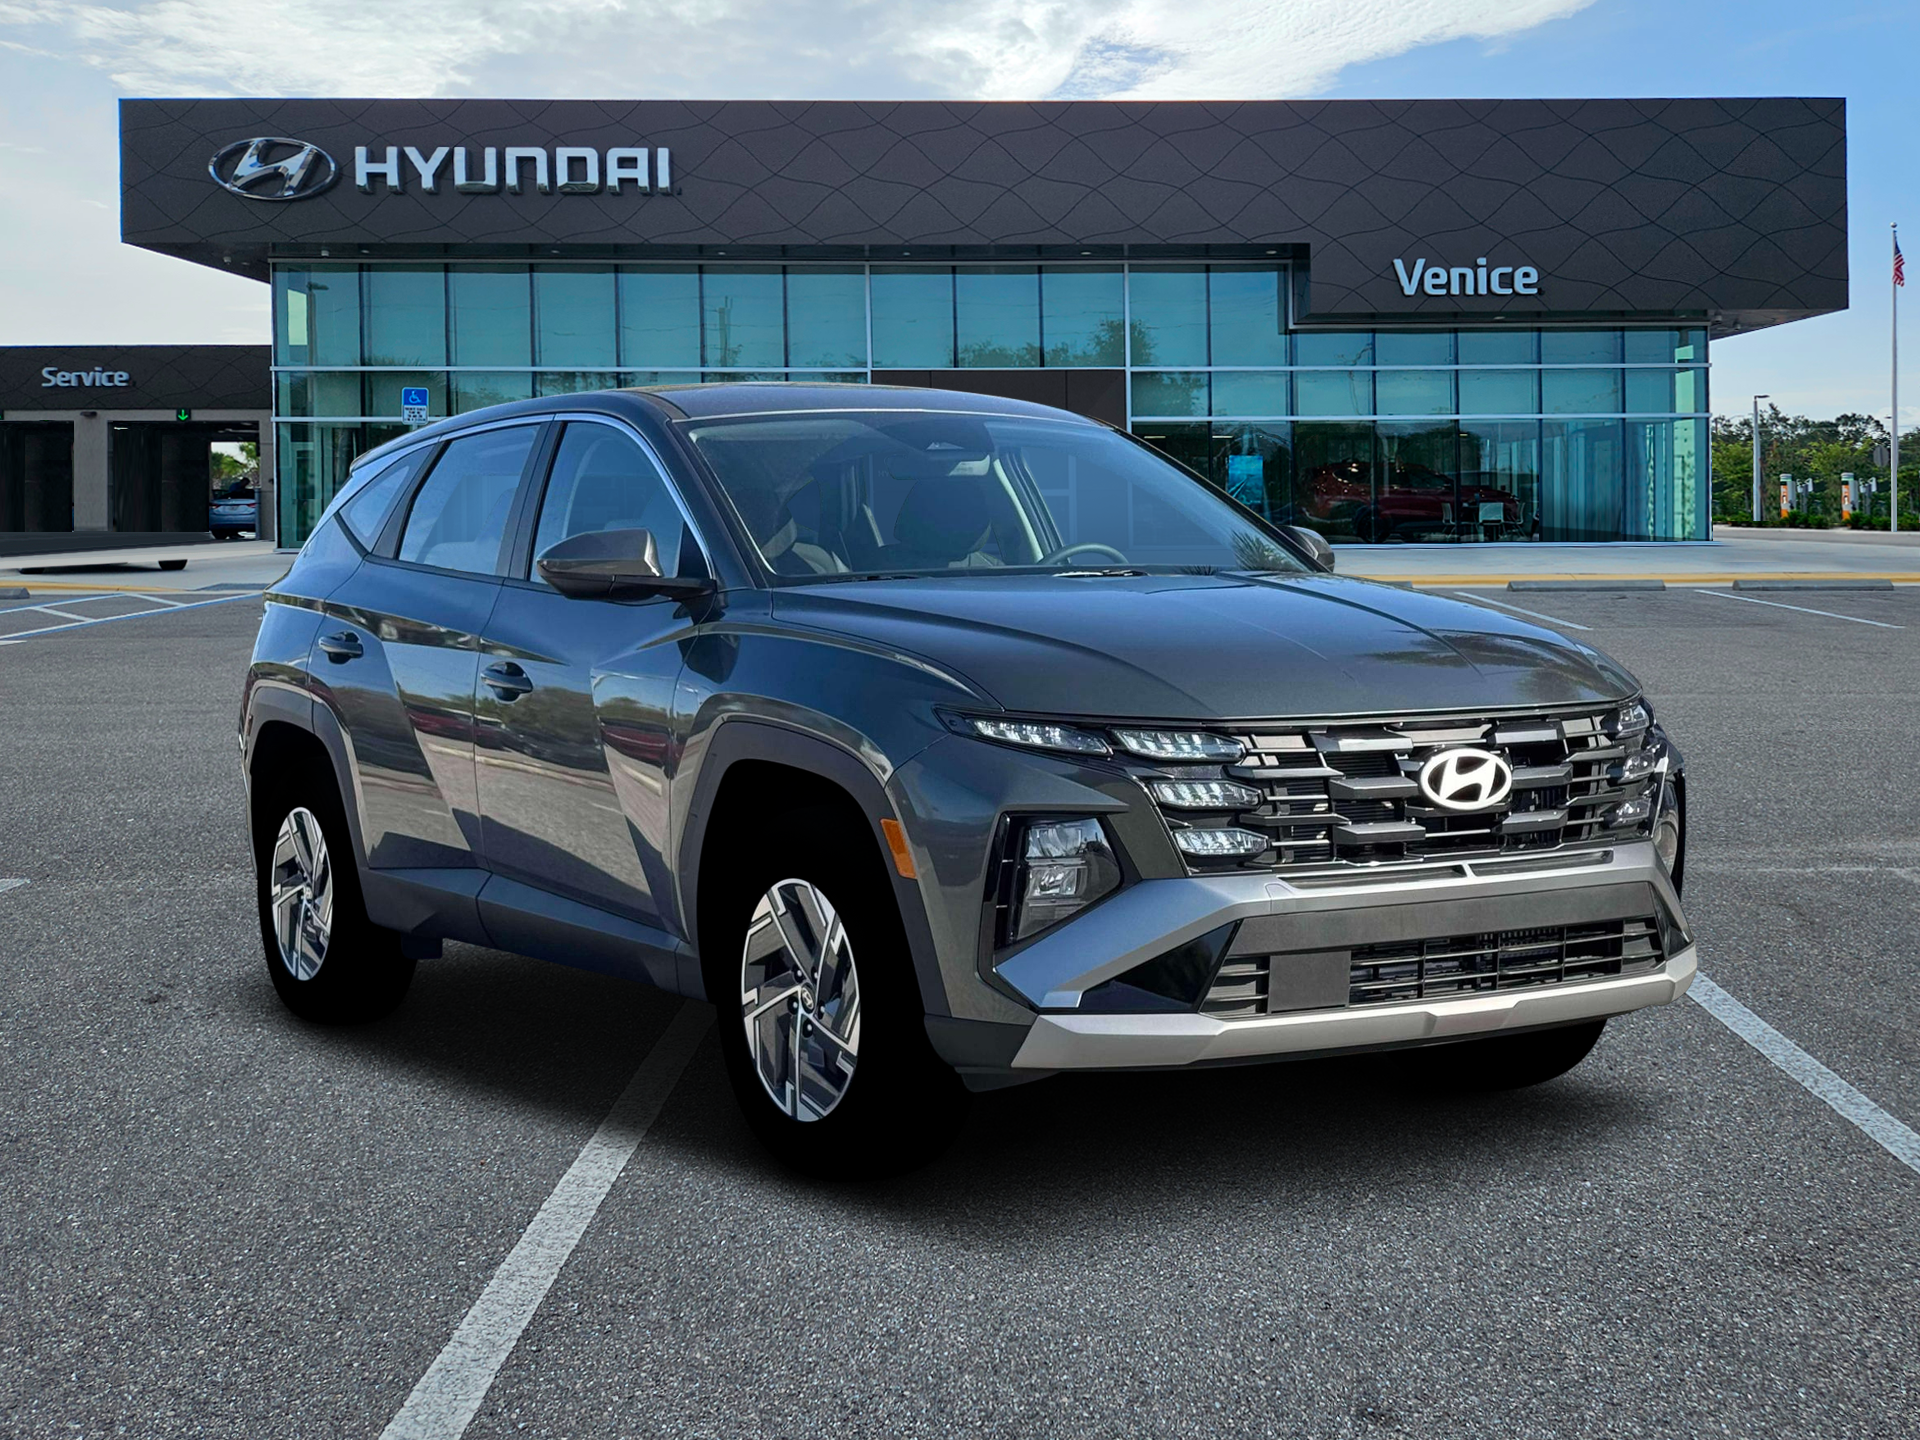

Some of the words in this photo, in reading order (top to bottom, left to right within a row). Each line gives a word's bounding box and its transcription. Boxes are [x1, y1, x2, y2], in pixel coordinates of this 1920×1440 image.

[354, 146, 670, 192] HYUNDAI
[1392, 256, 1539, 296] Venice
[41, 366, 130, 387] Service
